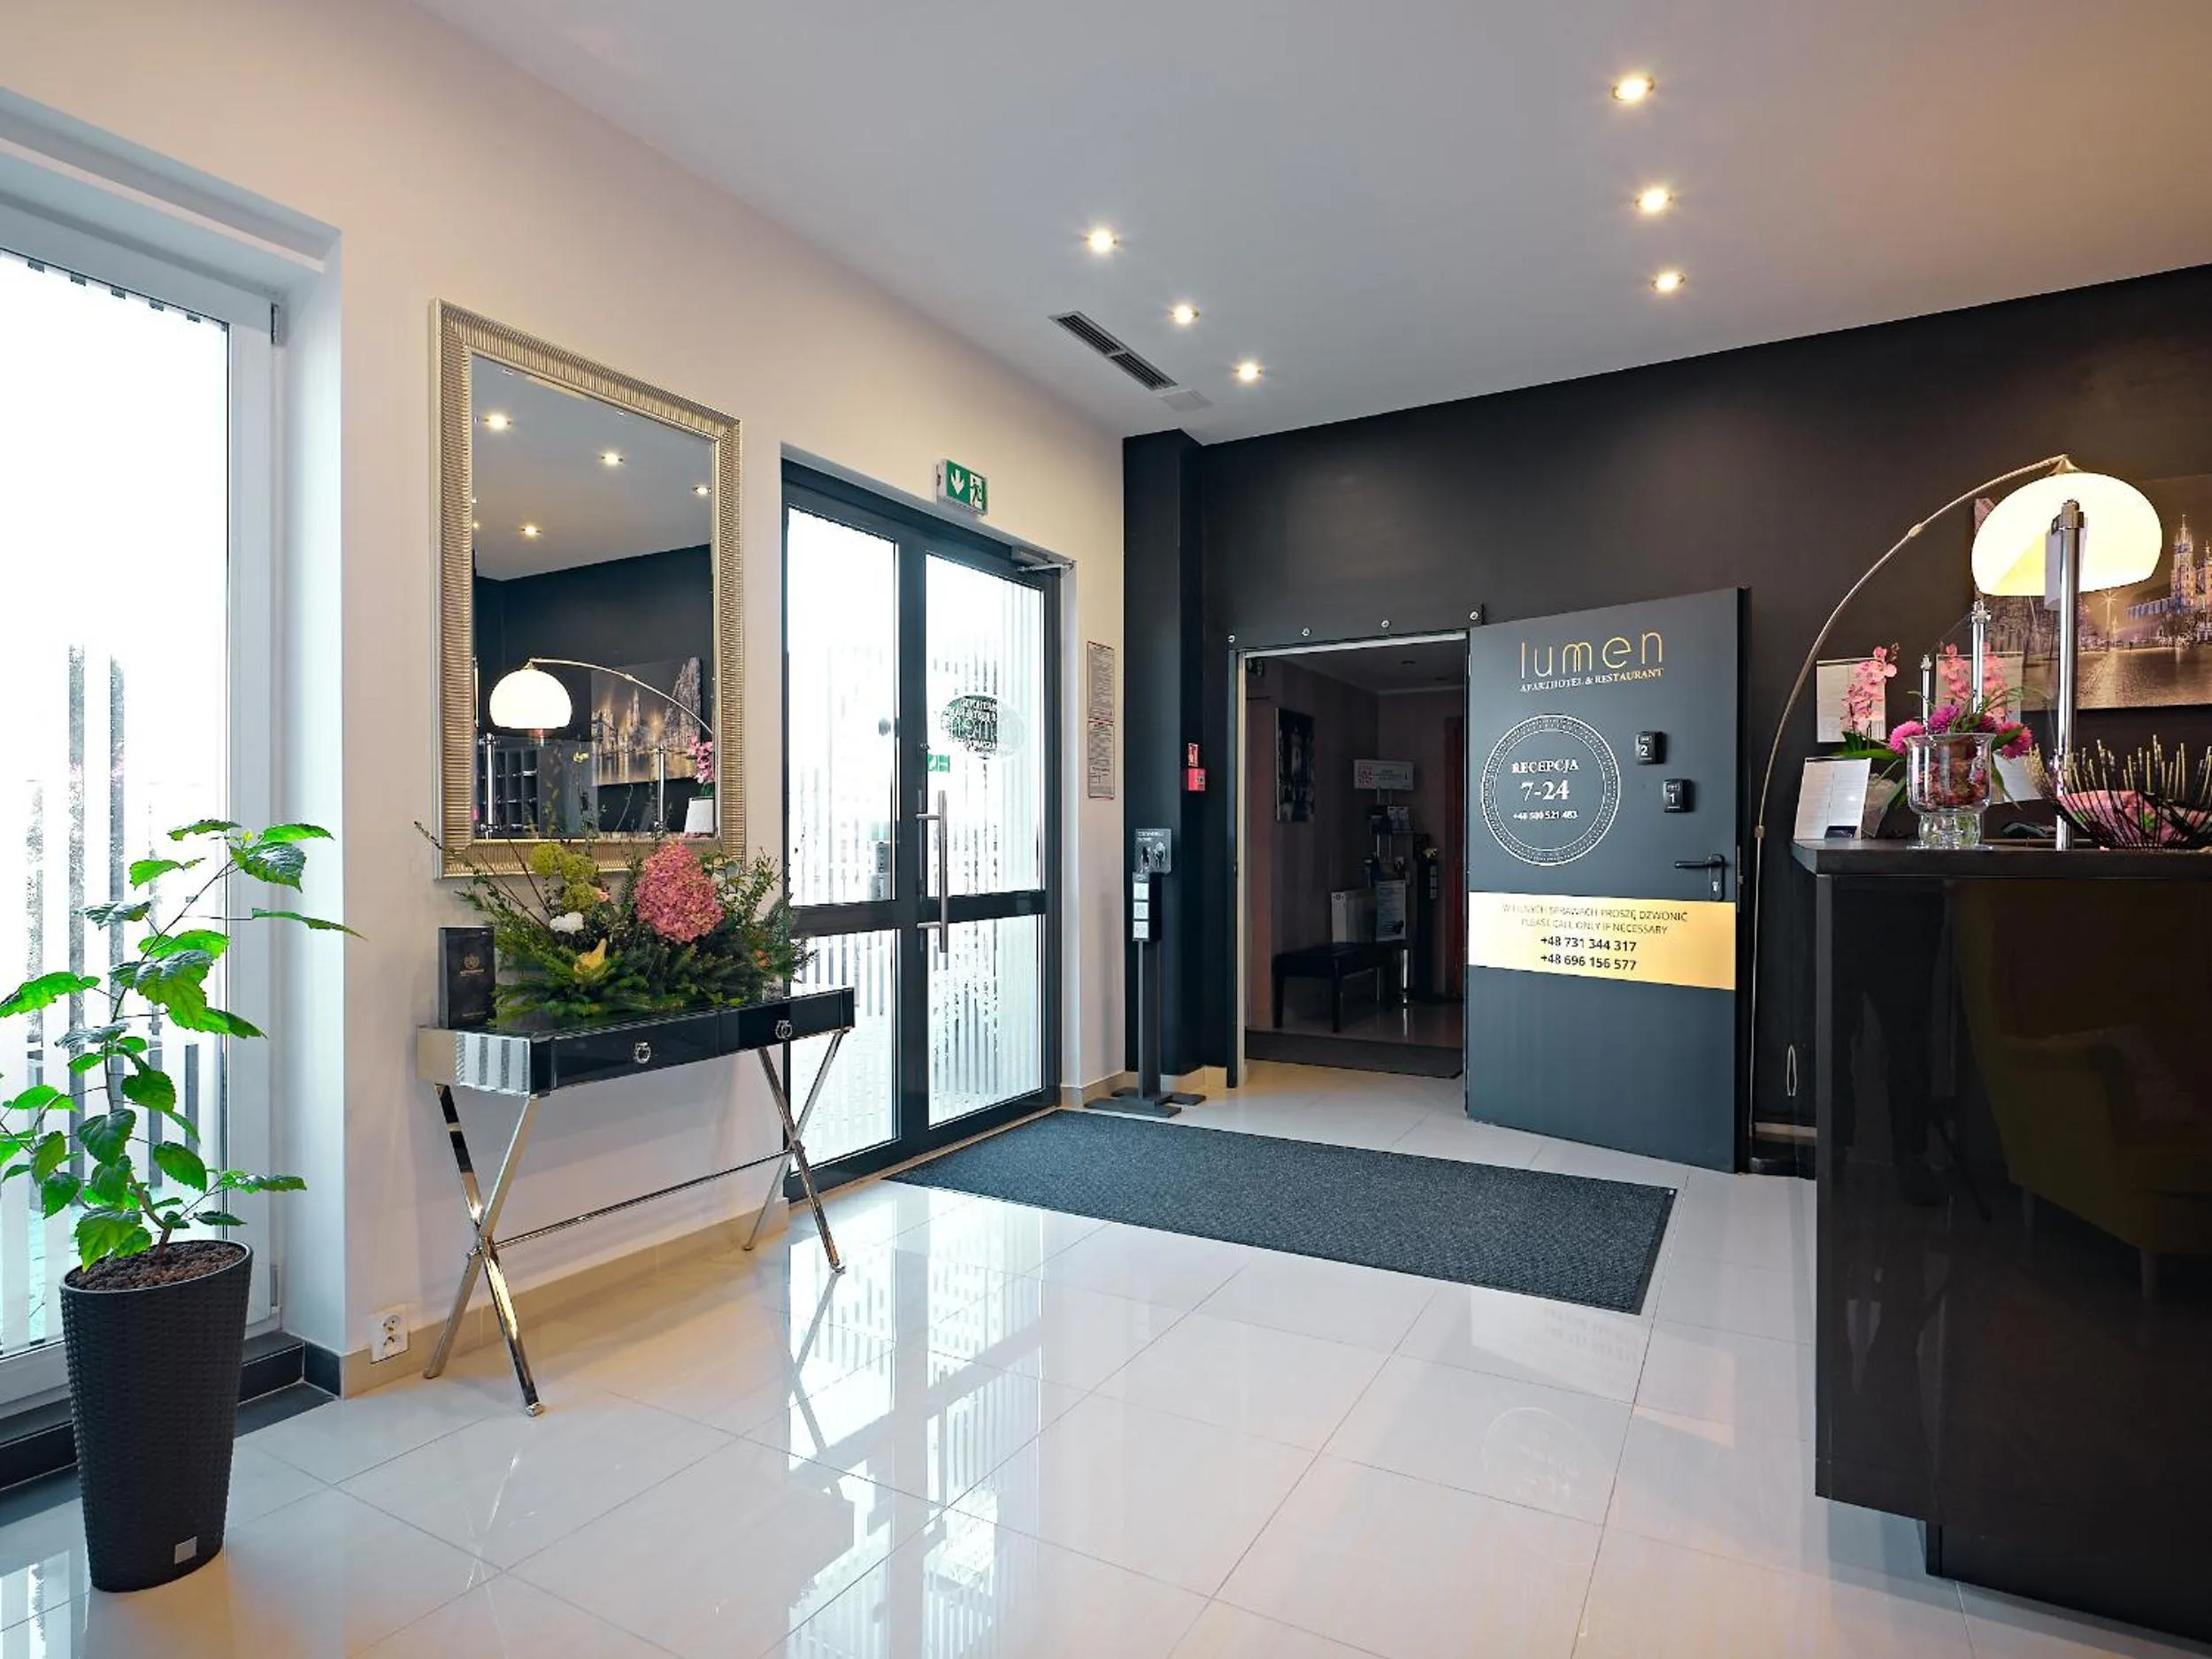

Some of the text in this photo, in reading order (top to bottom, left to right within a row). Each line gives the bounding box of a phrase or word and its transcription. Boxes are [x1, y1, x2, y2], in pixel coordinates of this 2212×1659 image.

[1521, 631, 1663, 679] lumen
[1585, 676, 1593, 686] &
[1595, 668, 1663, 684] RESTAURANT
[1640, 744, 1648, 757] 2
[1511, 759, 1579, 773] RECEPCJA
[1520, 780, 1570, 802] 7-24
[1613, 923, 1668, 934] NECESSARY
[1540, 936, 1637, 952] +48 731 344 317
[1540, 954, 1561, 964] +48
[1564, 956, 1586, 966] 696
[1614, 959, 1637, 971] 577
